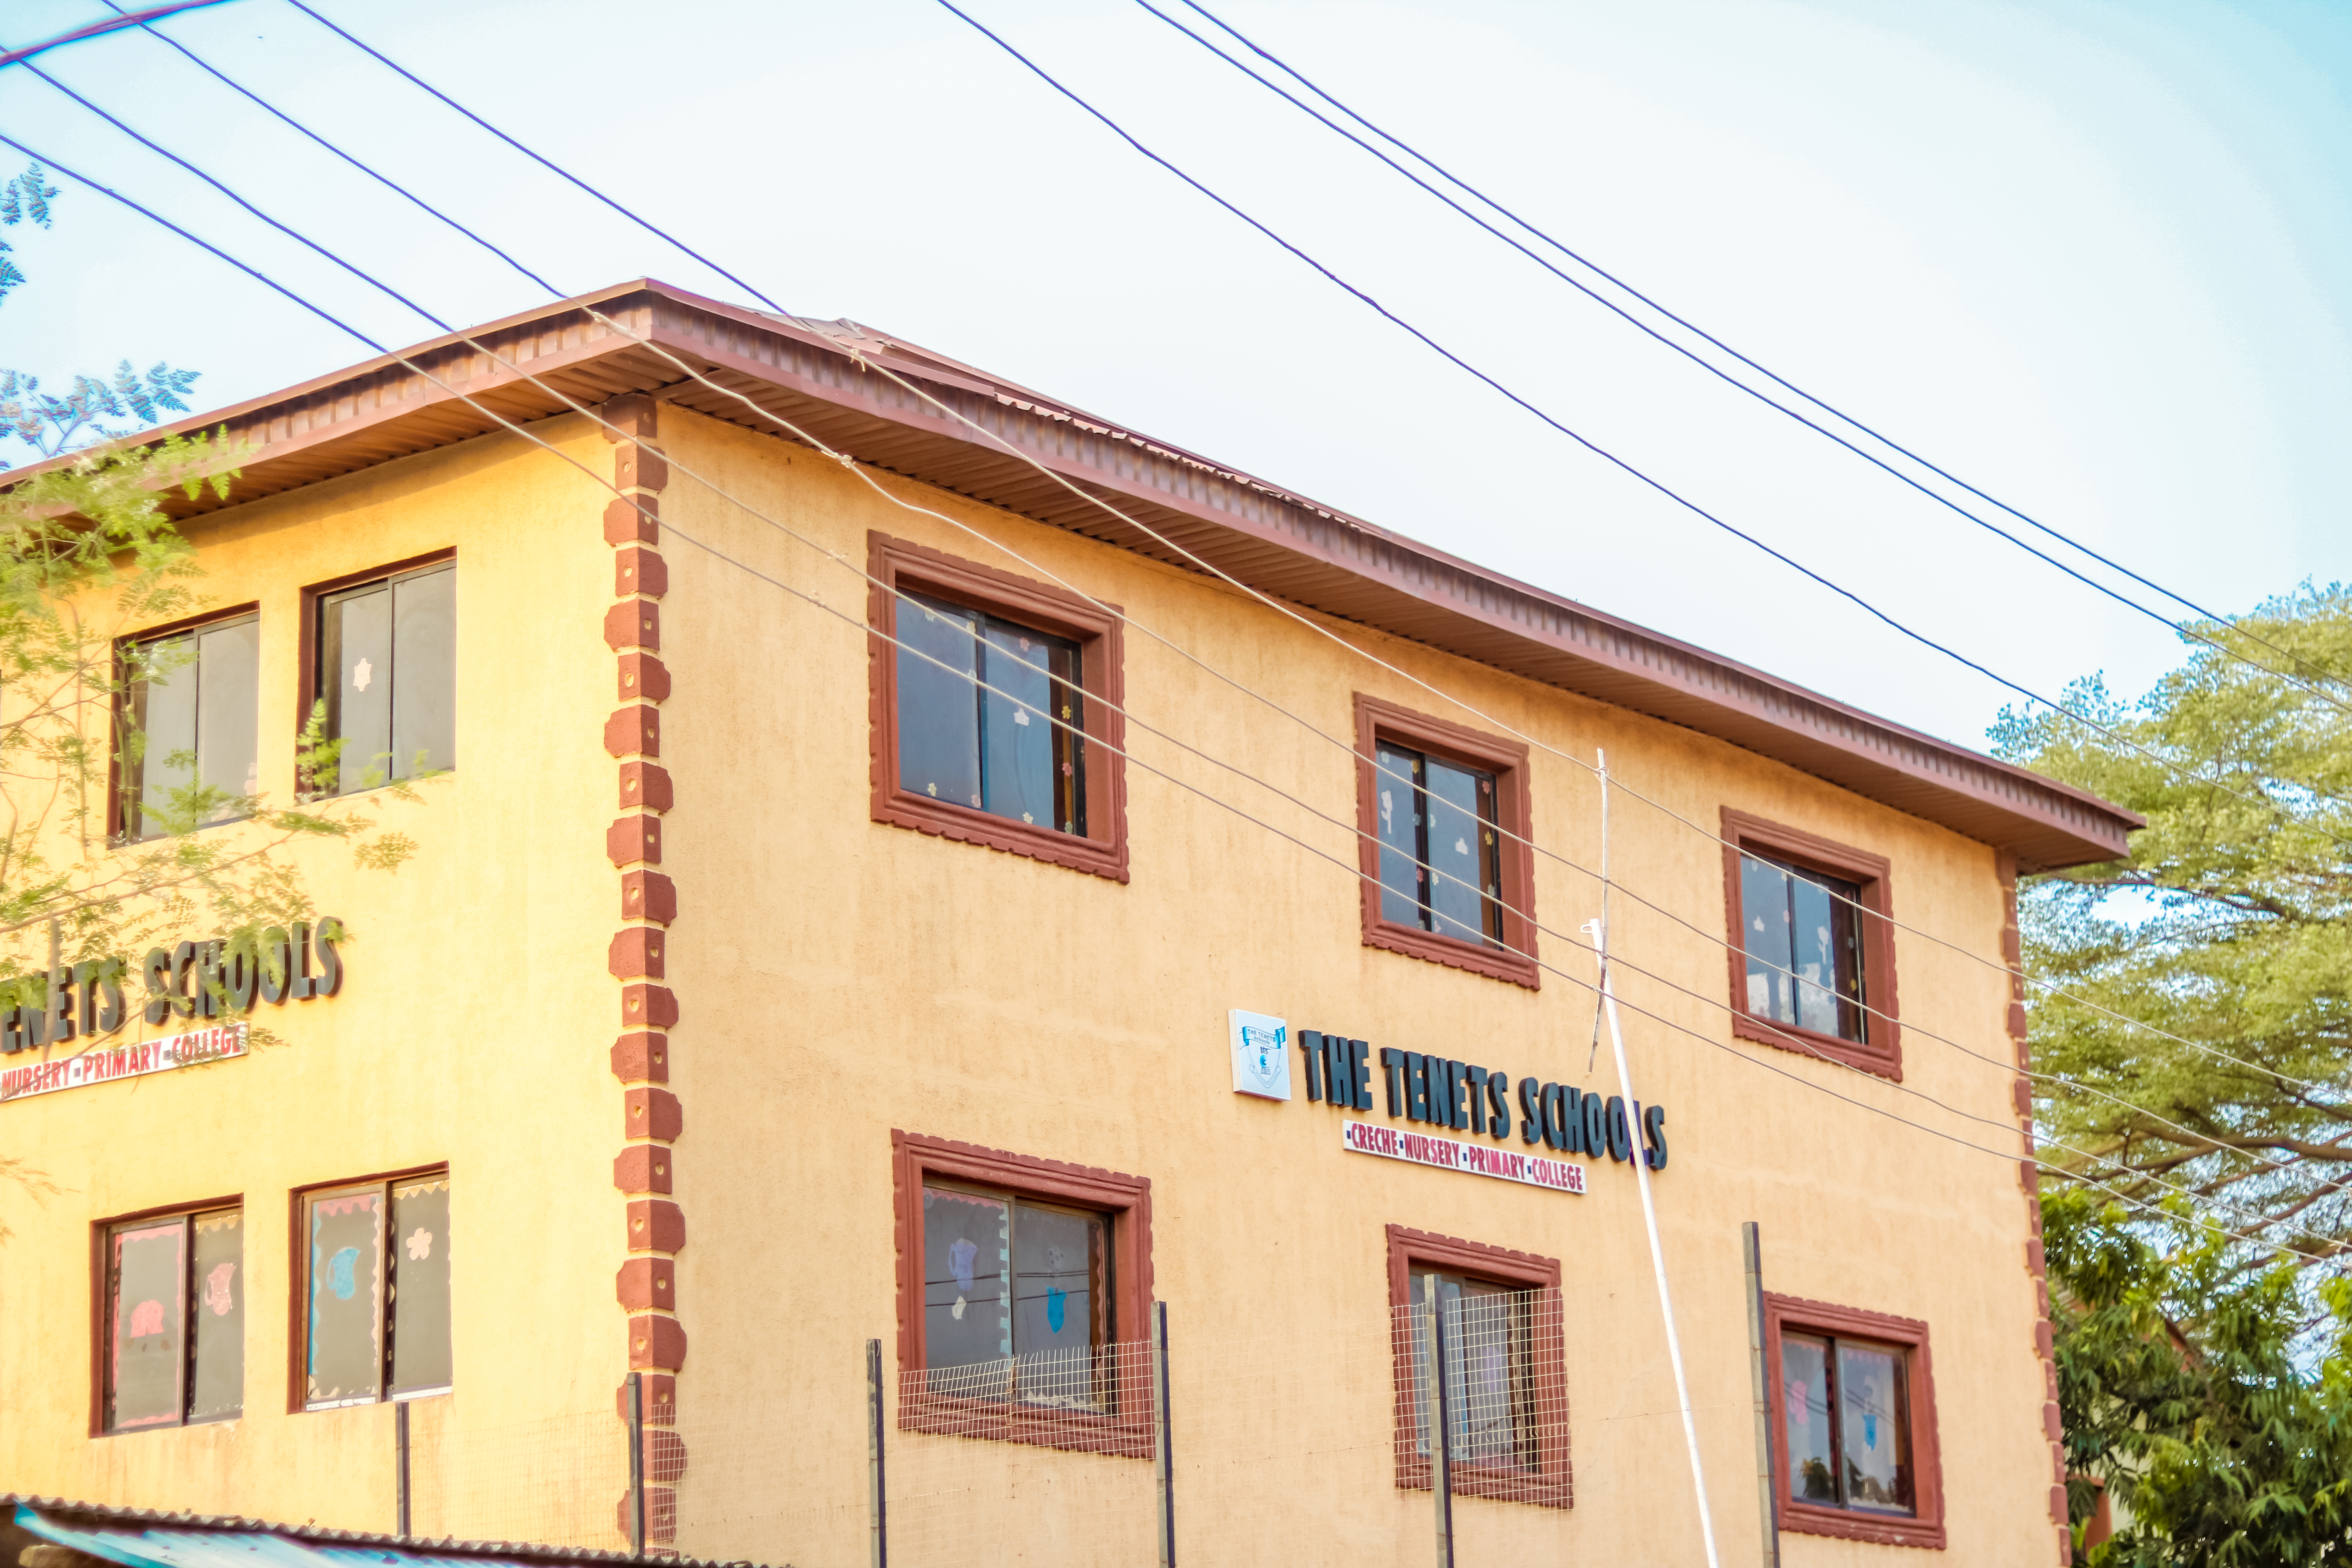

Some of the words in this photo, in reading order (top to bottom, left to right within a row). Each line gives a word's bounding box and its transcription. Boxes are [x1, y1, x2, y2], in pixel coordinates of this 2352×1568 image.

[143, 916, 344, 1026] SCHOOLS
[0, 1059, 71, 1097] NURSERY
[83, 1041, 162, 1082] PRIMARY
[172, 1025, 241, 1065] COLLEGE
[1259, 1032, 1275, 1042] TENETS
[1298, 1029, 1373, 1111] THE
[1380, 1047, 1511, 1140] TENETS
[1351, 1123, 1398, 1156] CRECHE
[1404, 1133, 1460, 1167] NURSERY
[1470, 1146, 1525, 1180] PRIMARY
[1532, 1158, 1583, 1191] COLLEGE
